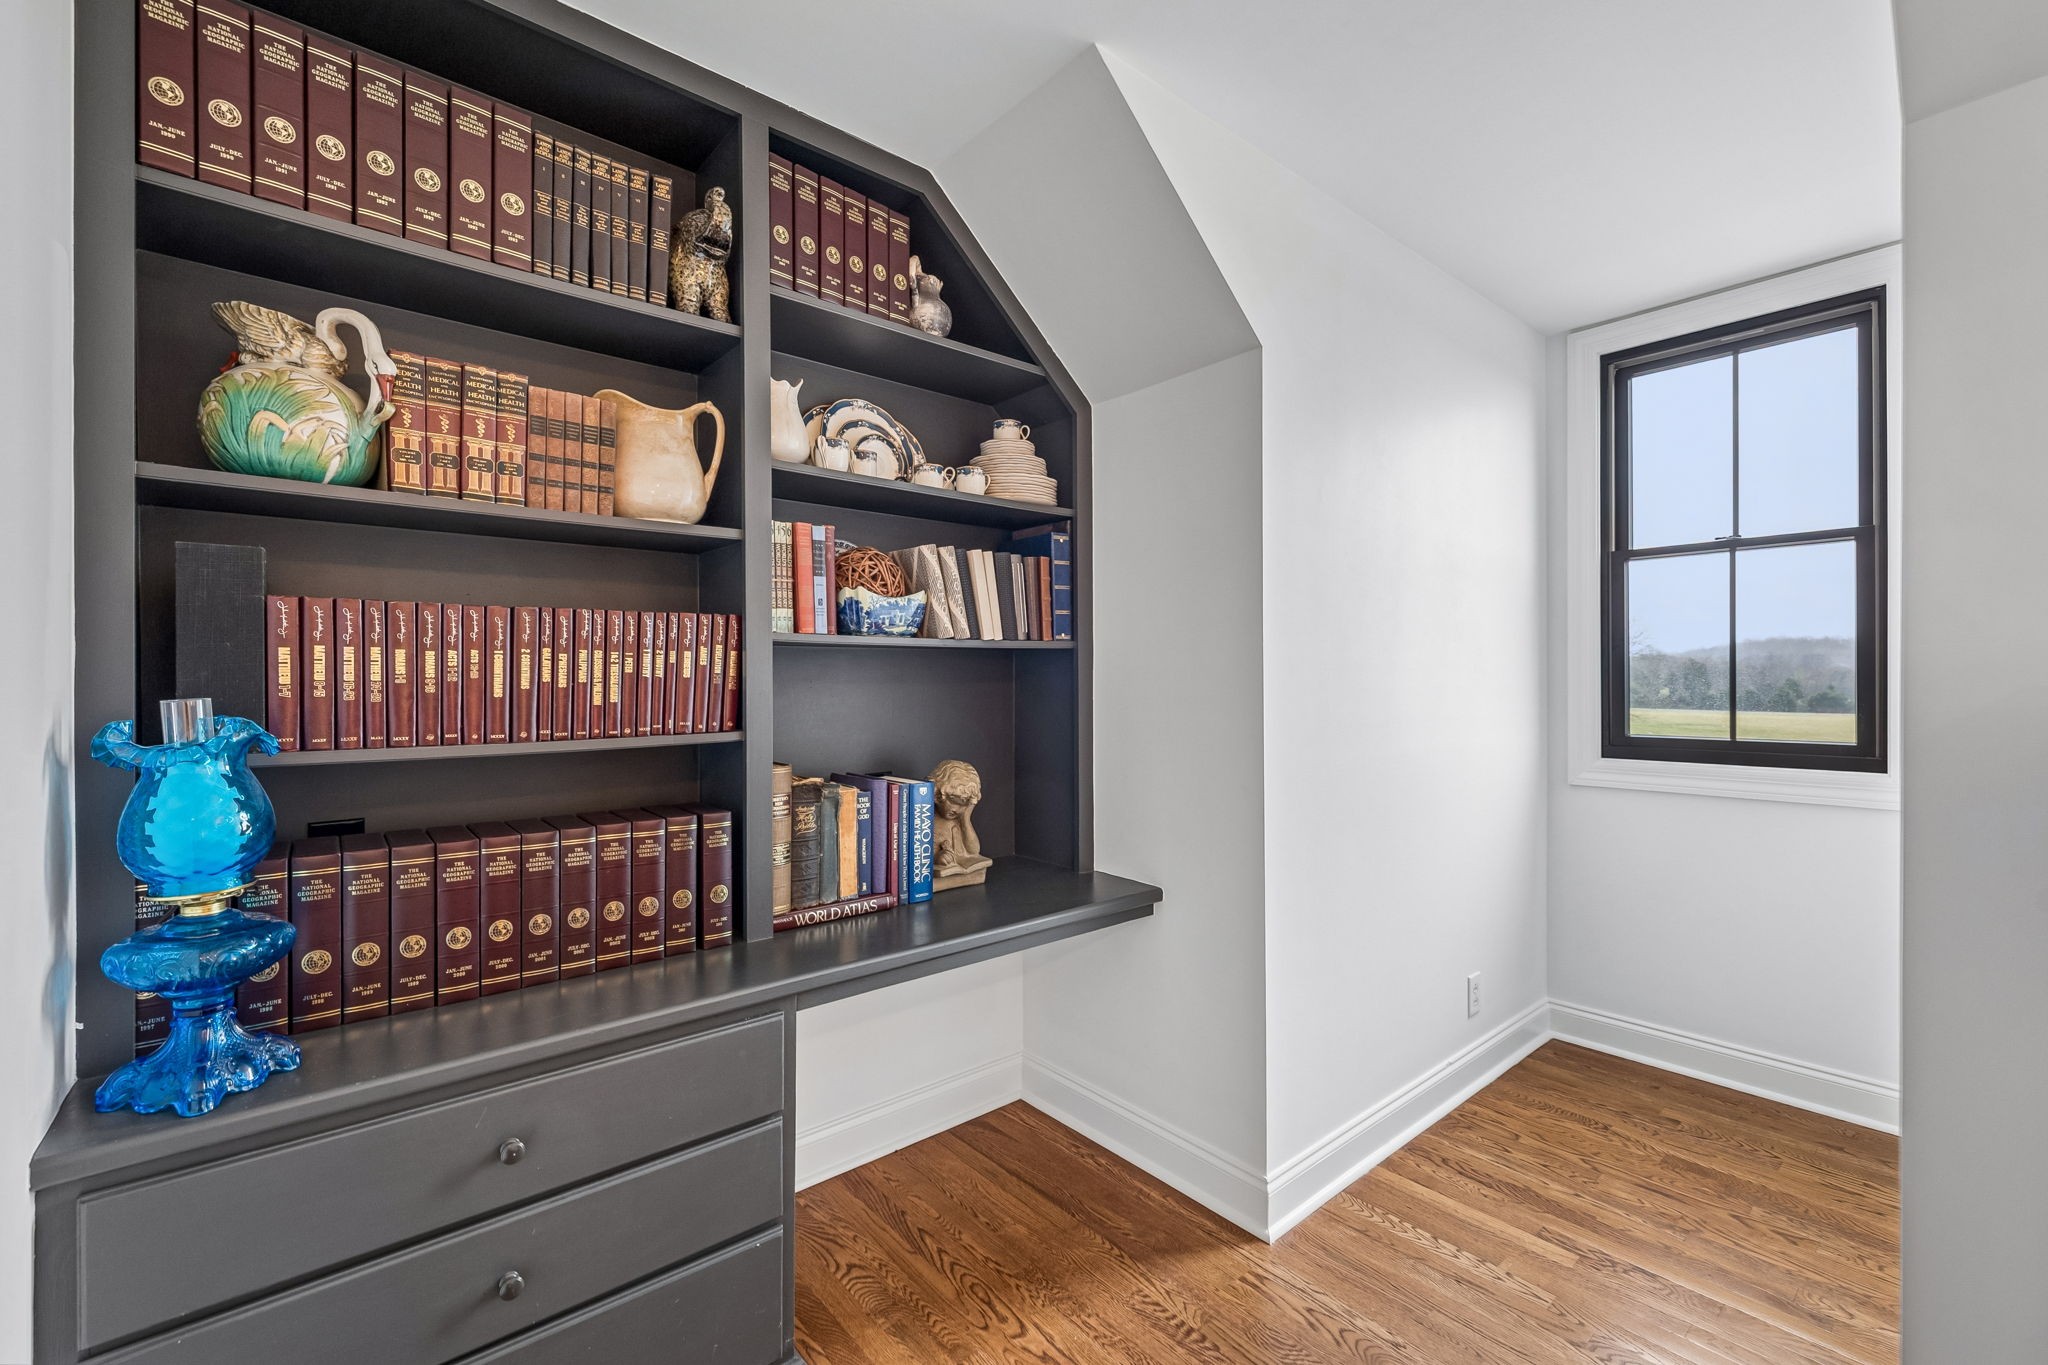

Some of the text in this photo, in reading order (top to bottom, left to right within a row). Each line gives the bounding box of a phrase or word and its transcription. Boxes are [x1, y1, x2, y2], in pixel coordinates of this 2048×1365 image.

[144, 3, 189, 26] GEOGRAPHIC
[148, 0, 184, 18] NATIONAL
[148, 11, 184, 30] MAGAZINE
[218, 22, 230, 32] THE
[202, 29, 244, 49] GEOGRAPHIC
[208, 24, 240, 41] NATIONAL
[206, 36, 241, 53] MAGAZINE
[264, 44, 295, 60] NATIONAL
[274, 42, 286, 51] THE
[260, 48, 299, 67] GEOGRAPHIC
[264, 55, 295, 71] MAGAZINE
[316, 64, 345, 80] NATIONAL
[324, 62, 336, 71] THE
[312, 68, 349, 87] GEOGRAPHIC
[316, 75, 345, 91] MAGAZINE
[376, 80, 386, 88] THE
[362, 86, 398, 103] GEOGRAPHIC
[368, 83, 394, 97] NATIONAL
[366, 93, 394, 107] MAGAZINE
[397, 370, 422, 380] EDICAL
[428, 376, 460, 386] MEDICAL
[431, 387, 459, 397] HEALTH
[467, 381, 496, 391] MEDICAL
[468, 392, 495, 402] HEALTH
[499, 398, 525, 408] HEALTH
[314, 645, 325, 680] MATTHEW
[344, 646, 354, 681] MATTHEW
[370, 647, 381, 681] MATTHEW
[395, 649, 406, 674] ROMANS
[448, 650, 457, 666] ACTS
[470, 650, 479, 663] ACTS
[699, 646, 707, 665] JAMES
[713, 645, 722, 673] REVELATION
[278, 647, 290, 684] MATTHEW
[425, 651, 435, 678] ROMANS
[521, 654, 530, 689] CORINTHIANS
[542, 648, 551, 682] GALATIANS
[558, 654, 567, 688] EPHESIANS
[624, 658, 633, 673] PETER
[493, 654, 503, 698] CORINTHIANS
[279, 685, 291, 698] 1-7
[921, 804, 931, 841] MAYO
[921, 844, 931, 882] CLINIC
[794, 900, 878, 927] WORLD ATLAS
